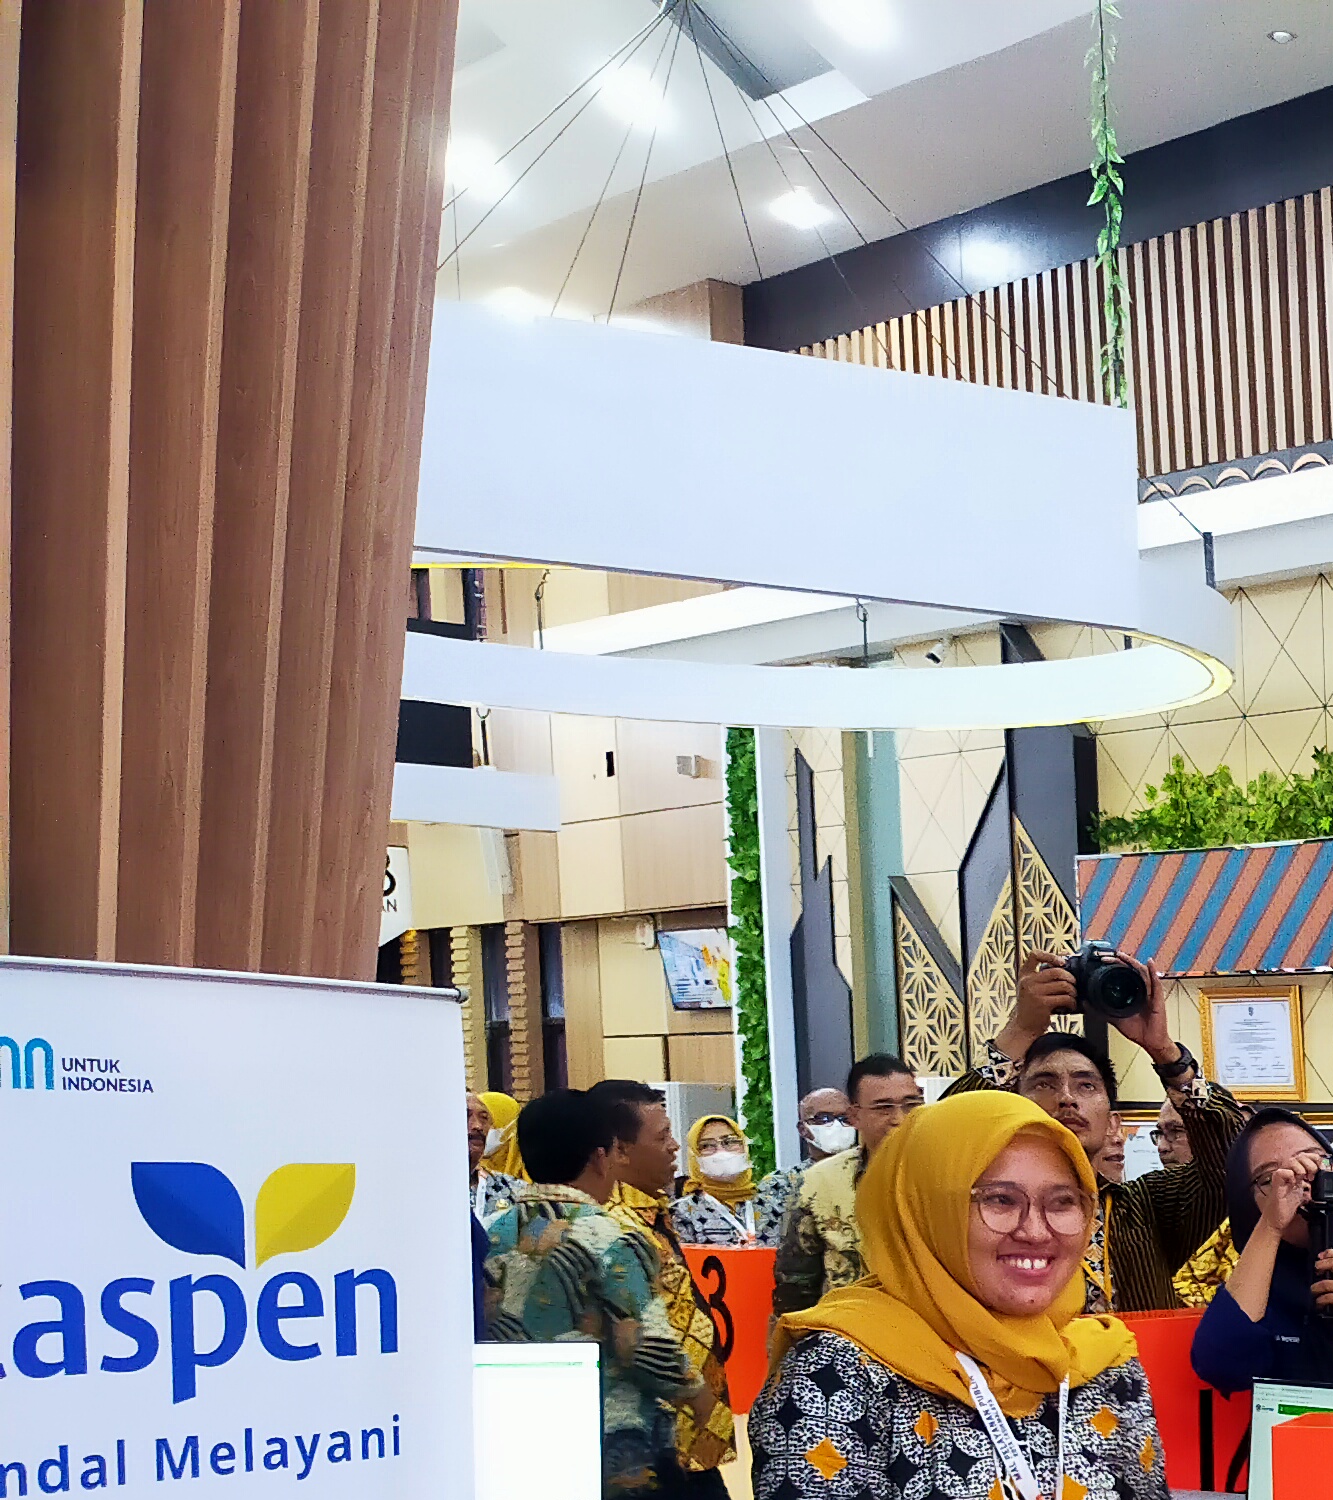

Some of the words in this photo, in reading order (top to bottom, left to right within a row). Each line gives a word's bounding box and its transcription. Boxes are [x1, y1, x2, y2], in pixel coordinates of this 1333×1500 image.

[62, 1058, 120, 1073] UNTUK
[62, 1077, 154, 1093] INDONESIA
[0, 1268, 398, 1404] aspen
[155, 1414, 401, 1481] Melayani
